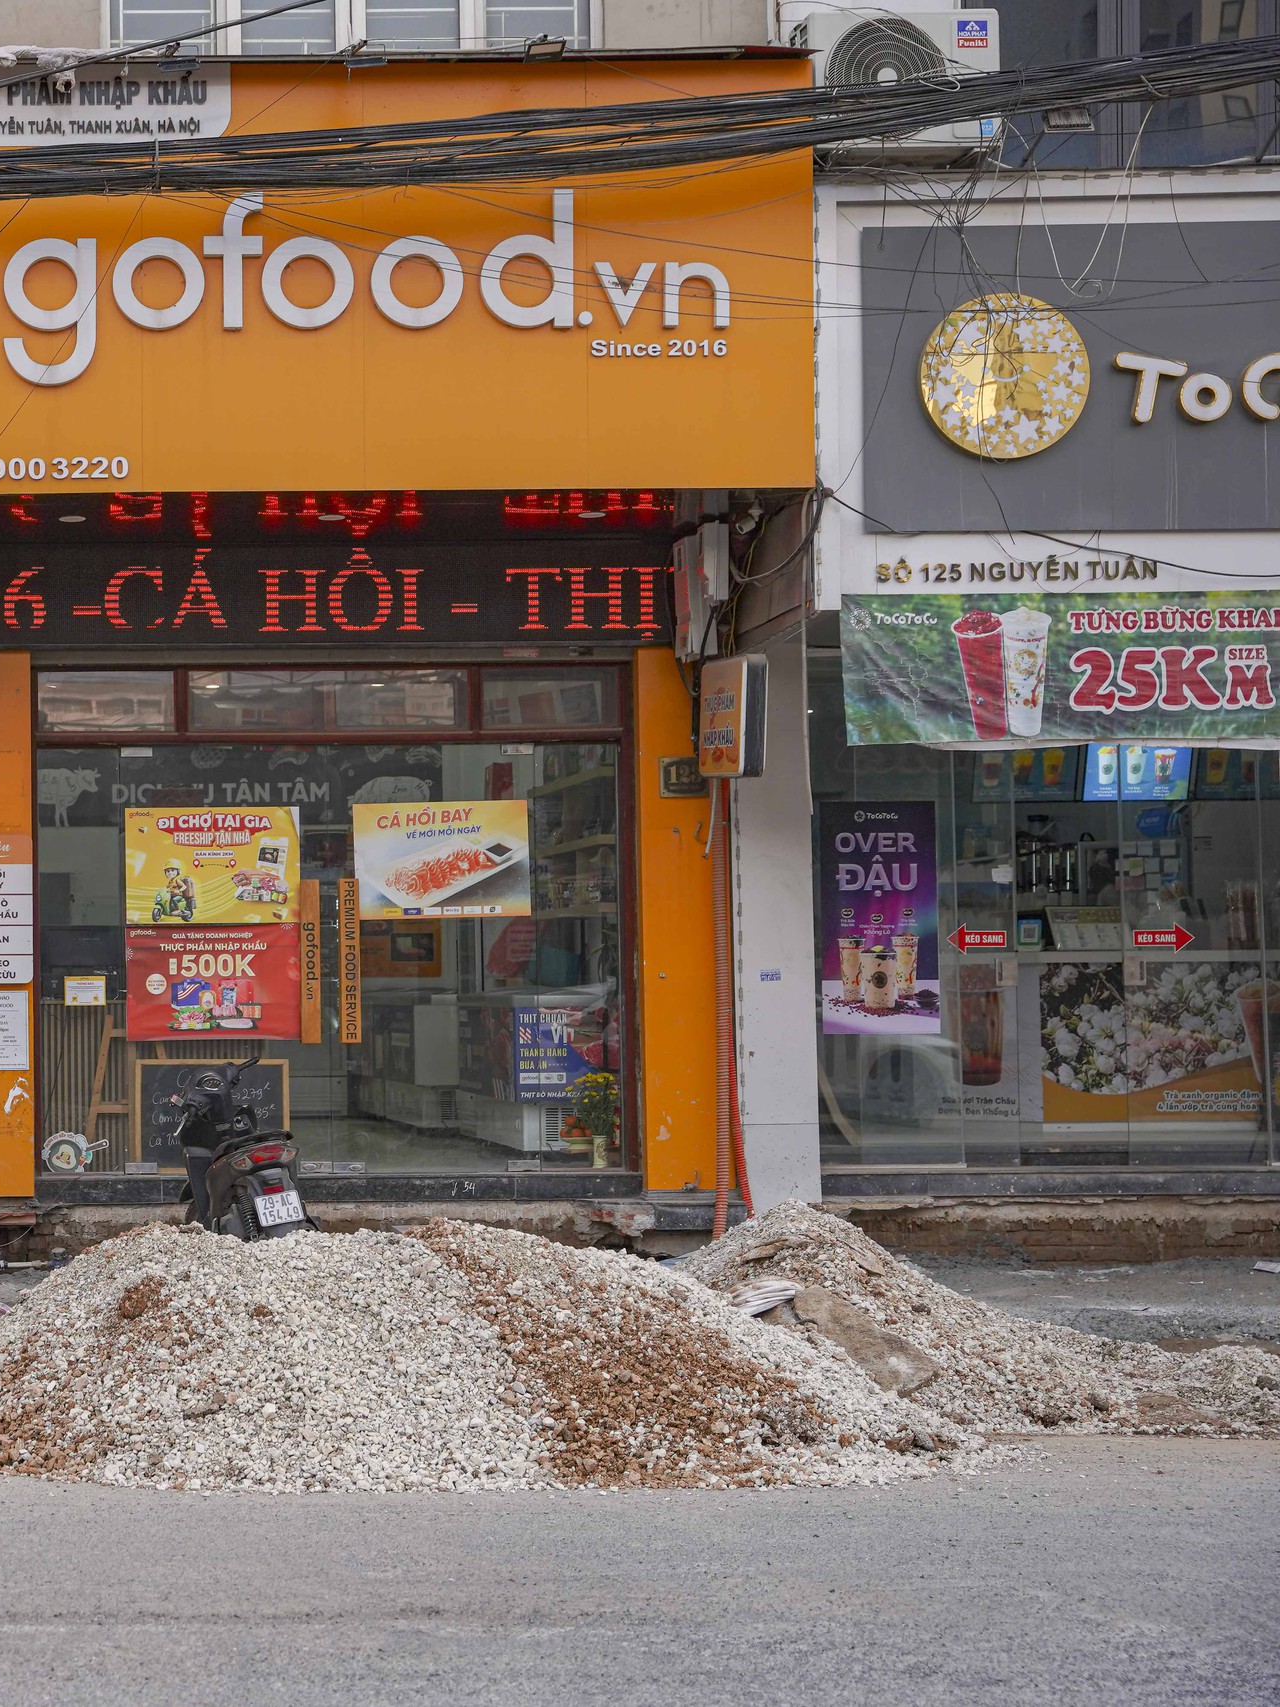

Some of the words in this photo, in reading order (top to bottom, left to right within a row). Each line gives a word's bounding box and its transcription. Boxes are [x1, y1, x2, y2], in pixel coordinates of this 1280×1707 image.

[80, 77, 141, 109] NHẬP
[69, 120, 112, 135] THANH
[157, 117, 176, 134] HÀ
[179, 116, 201, 136] NỘI
[590, 338, 664, 358] Since
[668, 338, 728, 358] 2016
[51, 456, 129, 480] 3220
[875, 556, 913, 584] SỐ
[919, 562, 962, 583] 125
[970, 555, 1079, 582] NGUYỄN
[1088, 555, 1159, 581] TUÂN
[1070, 608, 1139, 631] TƯNG
[1144, 606, 1213, 631] BỪNG
[1228, 647, 1266, 661] SIZE
[1071, 647, 1222, 711] 25K
[1226, 664, 1275, 706] M
[111, 784, 153, 806] DỊC
[277, 777, 330, 803] TÂM
[157, 816, 175, 829] ĐI
[178, 811, 213, 832] CHỢ
[214, 814, 241, 831] TẠI
[243, 815, 272, 829] GIA
[376, 811, 402, 830] CÁ
[406, 807, 436, 827] HỒI
[440, 807, 473, 824] BAY
[173, 831, 214, 846] FREESHIP
[214, 830, 232, 847] TẬN
[232, 829, 252, 845] NHÀ
[457, 825, 482, 835] NGÀY
[835, 832, 918, 853] OVER
[835, 855, 919, 897] ĐẬU
[344, 881, 356, 941] PREMIUM
[159, 943, 185, 953] THỰC
[187, 941, 213, 951] PHẨM
[215, 942, 240, 952] NHẬP
[242, 940, 267, 951] KHẨU
[187, 932, 205, 941] TẶNG
[229, 931, 253, 941] NGHIỆP
[965, 932, 981, 943] KÉO
[982, 933, 1003, 943] SANG
[1137, 932, 1154, 943] KÉO
[1155, 932, 1177, 942] SANG
[181, 954, 256, 977] 500K
[303, 922, 319, 1000] gofood.vn
[345, 945, 356, 981] FOOD
[345, 984, 357, 1041] SERVICE
[1164, 1090, 1179, 1100] Trà
[1181, 1089, 1202, 1100] xanh
[1204, 1090, 1239, 1101] organic
[1240, 1089, 1260, 1101] đậm
[1200, 1103, 1214, 1111] trà
[1240, 1102, 1257, 1111] hoa
[261, 1193, 294, 1211] 29-AC
[262, 1206, 300, 1225] 154.49
